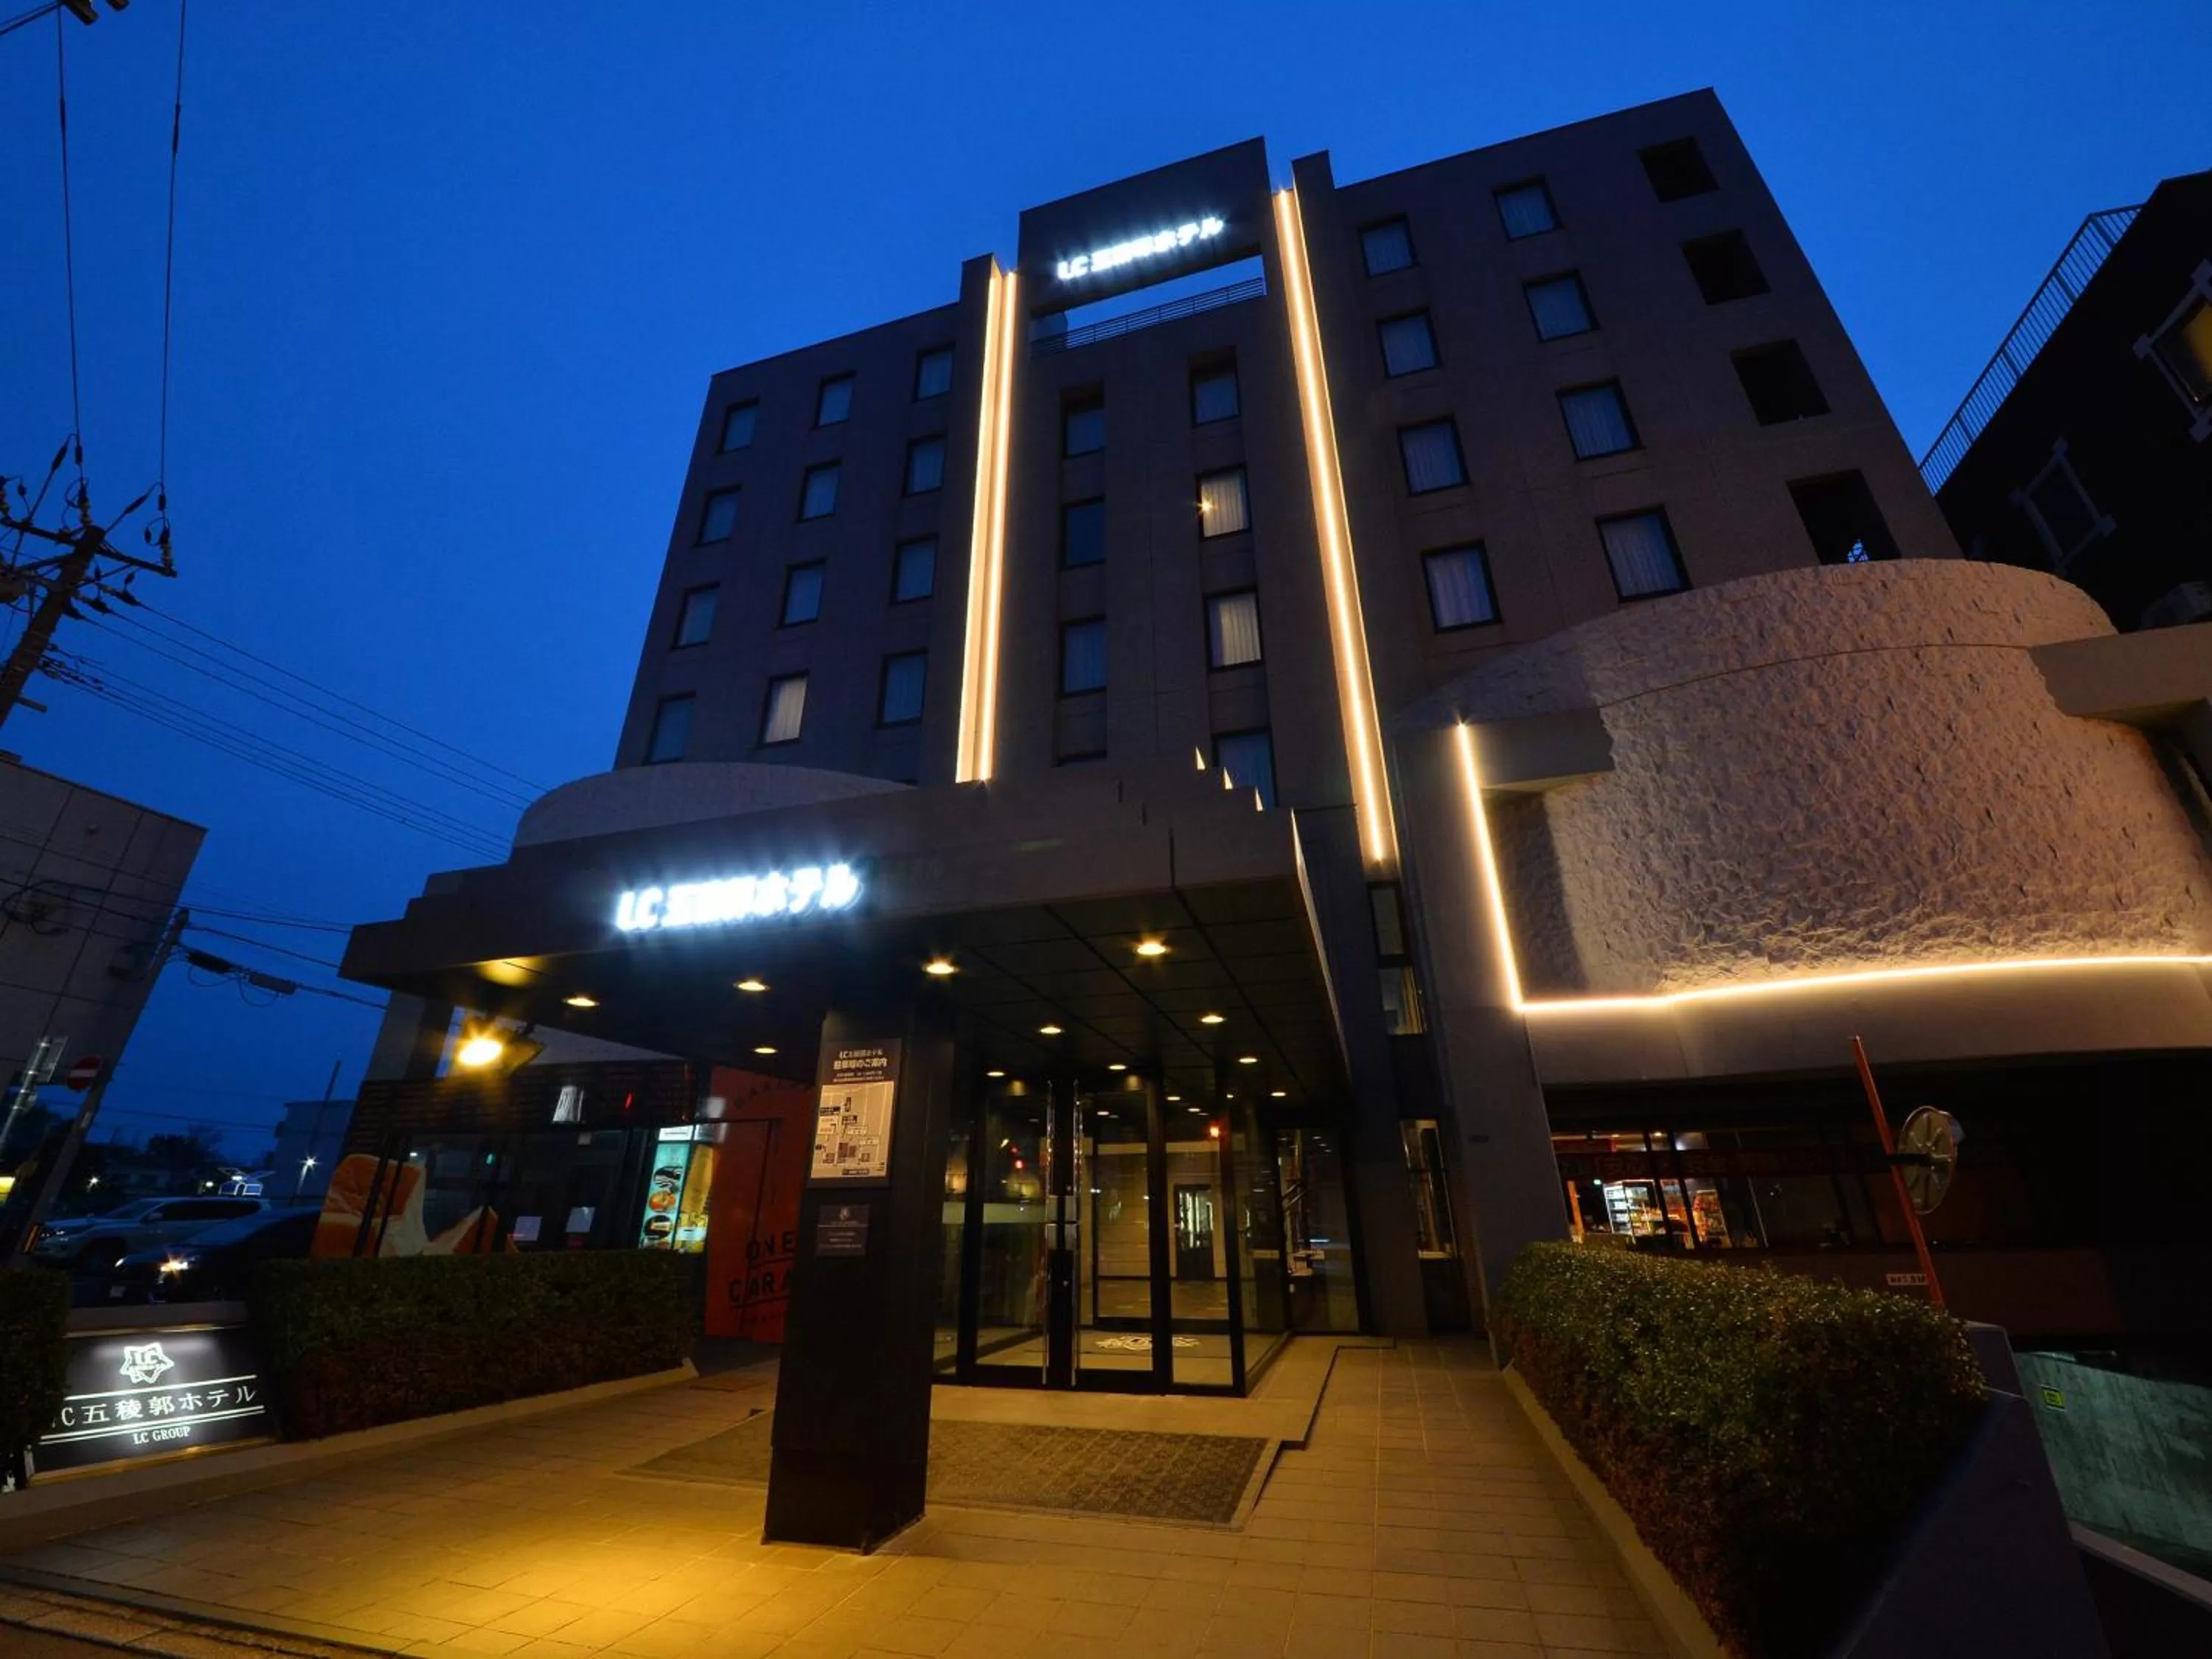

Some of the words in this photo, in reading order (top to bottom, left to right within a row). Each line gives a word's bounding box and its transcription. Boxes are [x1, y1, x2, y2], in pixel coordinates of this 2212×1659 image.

[616, 864, 860, 931] LC五ホテル
[53, 1385, 257, 1428] C五稜郭ホテル
[133, 1432, 149, 1444] LC
[153, 1426, 191, 1442] GROUP
